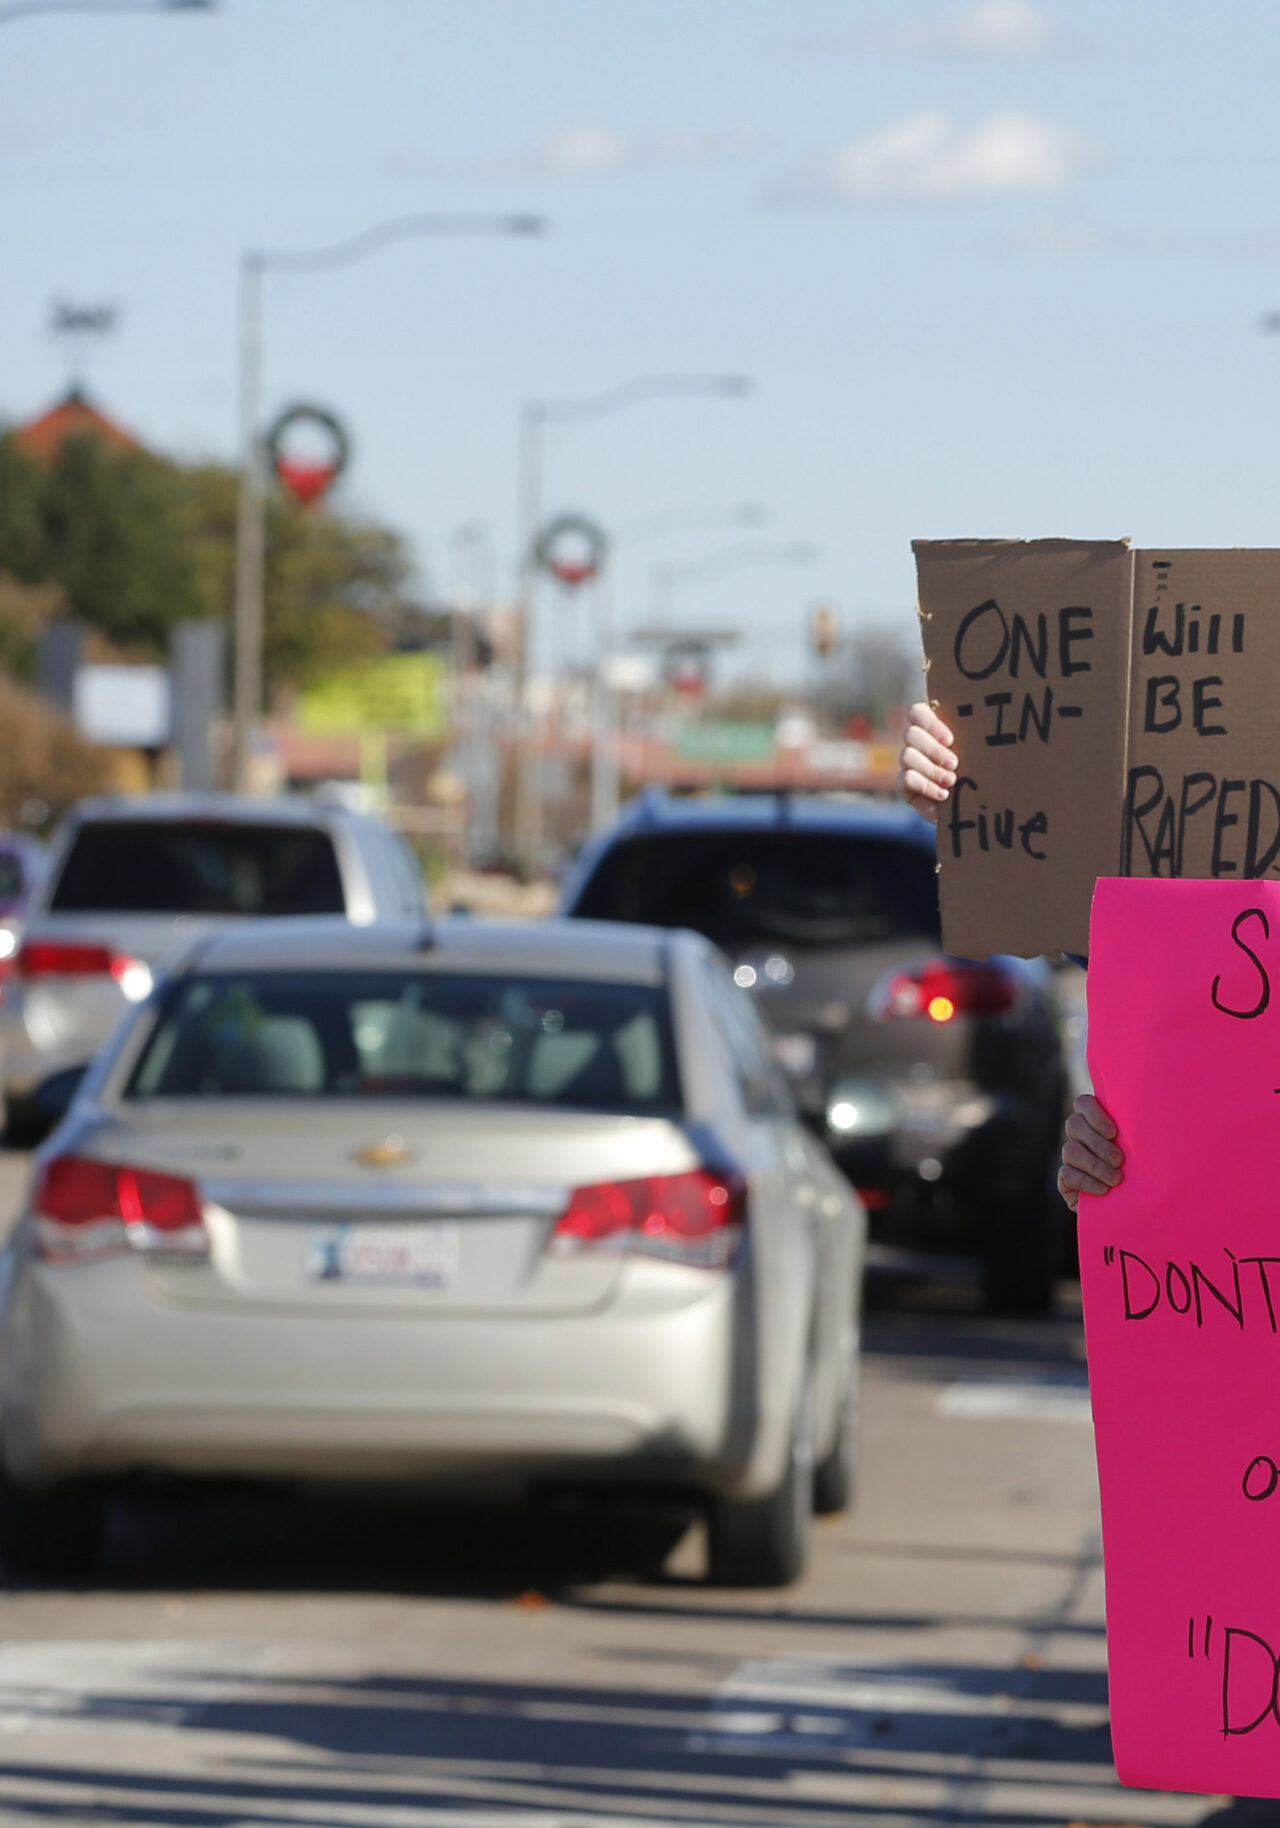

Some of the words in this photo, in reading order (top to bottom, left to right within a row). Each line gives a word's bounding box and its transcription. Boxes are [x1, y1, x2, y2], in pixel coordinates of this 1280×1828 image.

[954, 599, 1095, 681] ONE
[1142, 602, 1245, 656] Will
[1144, 675, 1229, 737] BE
[948, 776, 1048, 861] five
